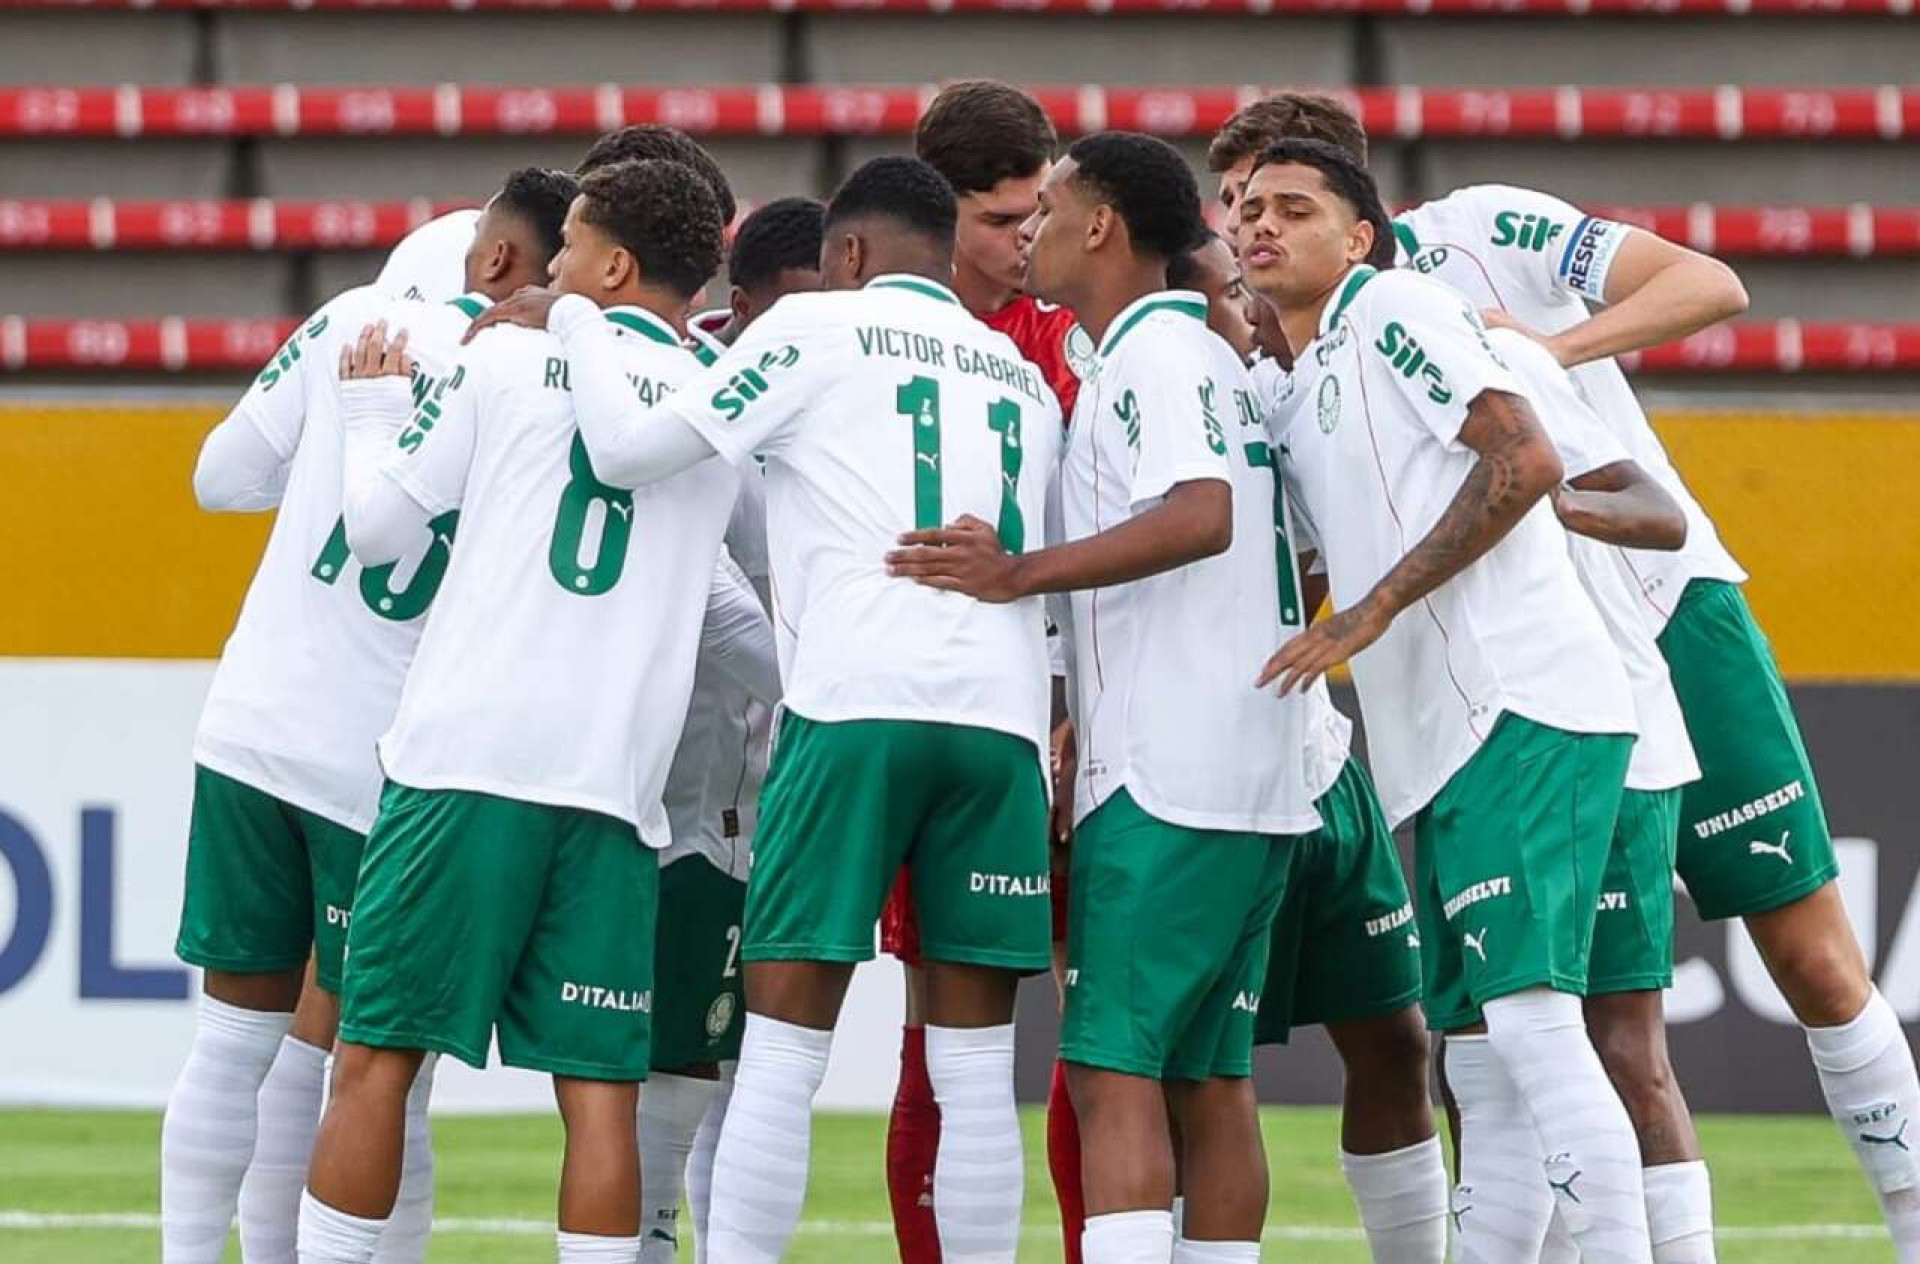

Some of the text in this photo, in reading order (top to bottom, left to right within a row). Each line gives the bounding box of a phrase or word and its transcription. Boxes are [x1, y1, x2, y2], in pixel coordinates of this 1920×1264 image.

[855, 326, 1046, 407] VICTOR GABRIEL
[896, 374, 1026, 554] 11
[1243, 441, 1301, 627] 7
[1694, 780, 1804, 839] UNIASSELVI
[0, 804, 189, 999] L
